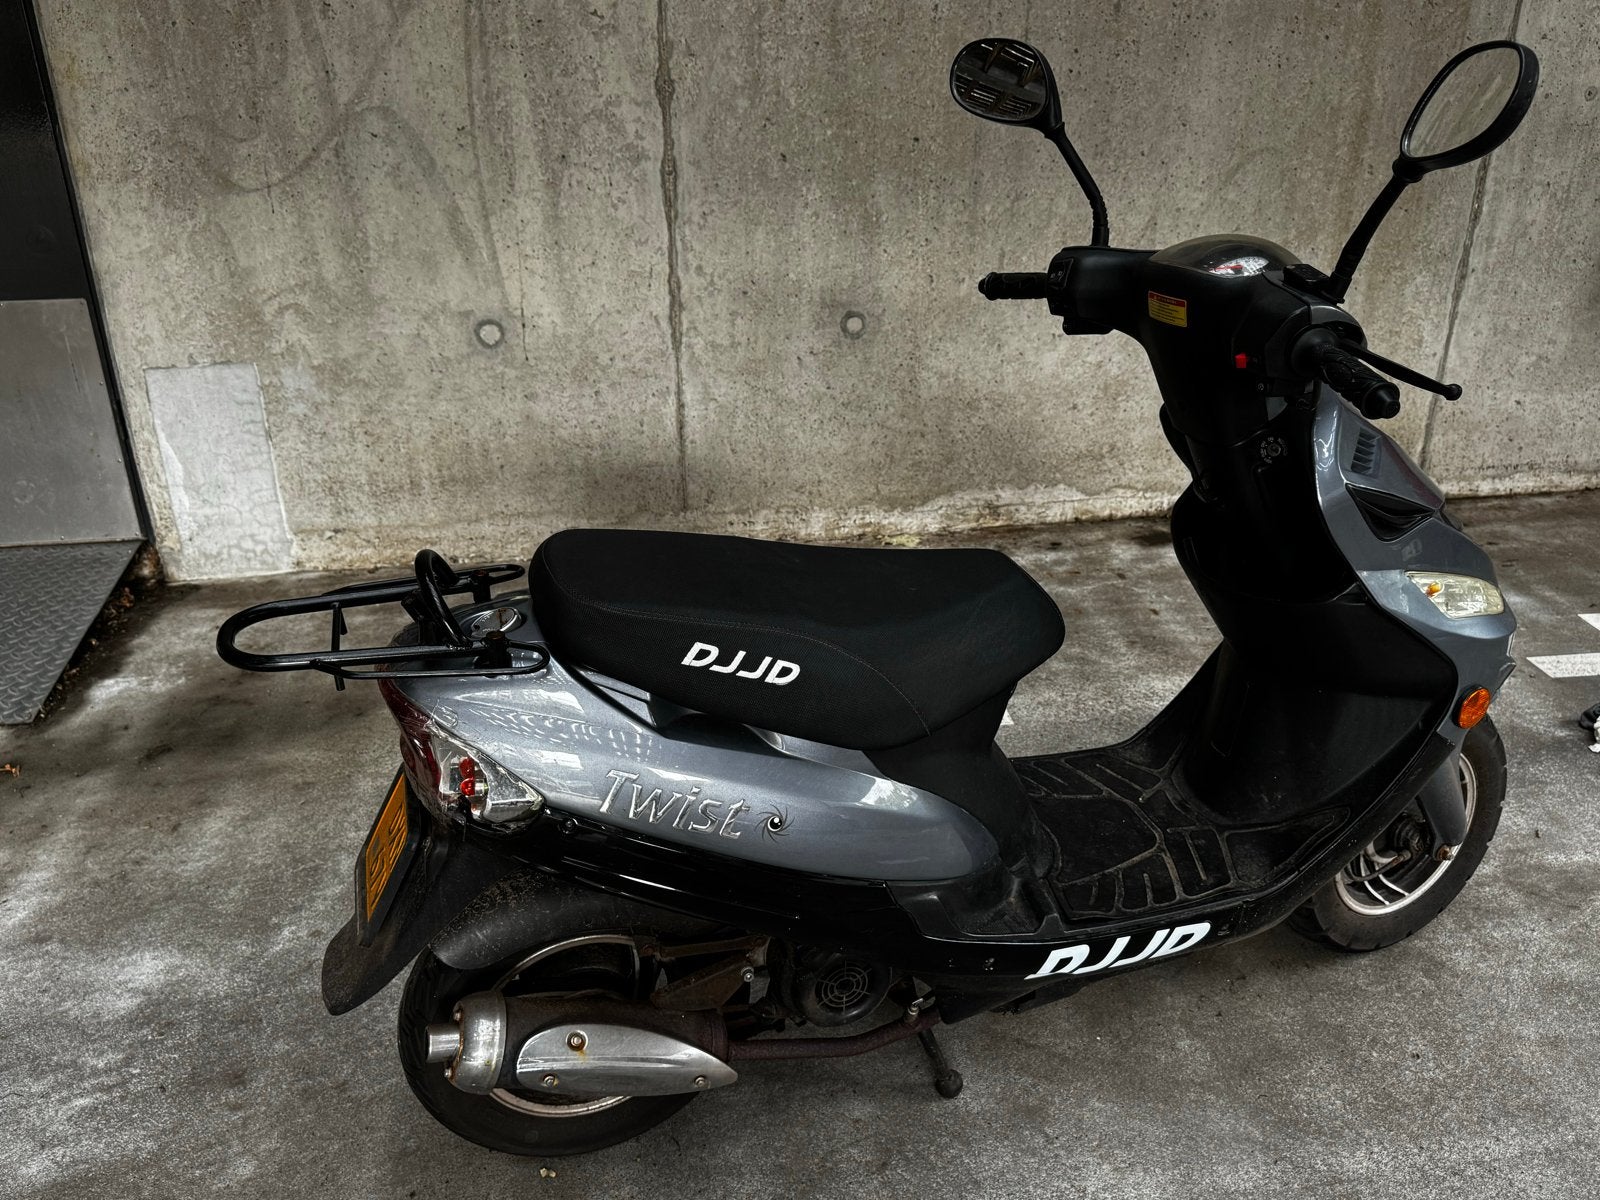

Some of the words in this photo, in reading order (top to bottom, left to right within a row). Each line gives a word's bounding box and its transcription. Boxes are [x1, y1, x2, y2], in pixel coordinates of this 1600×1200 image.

[681, 641, 801, 686] DJJD
[600, 769, 750, 840] Twist
[1024, 922, 1211, 980] DJJD
